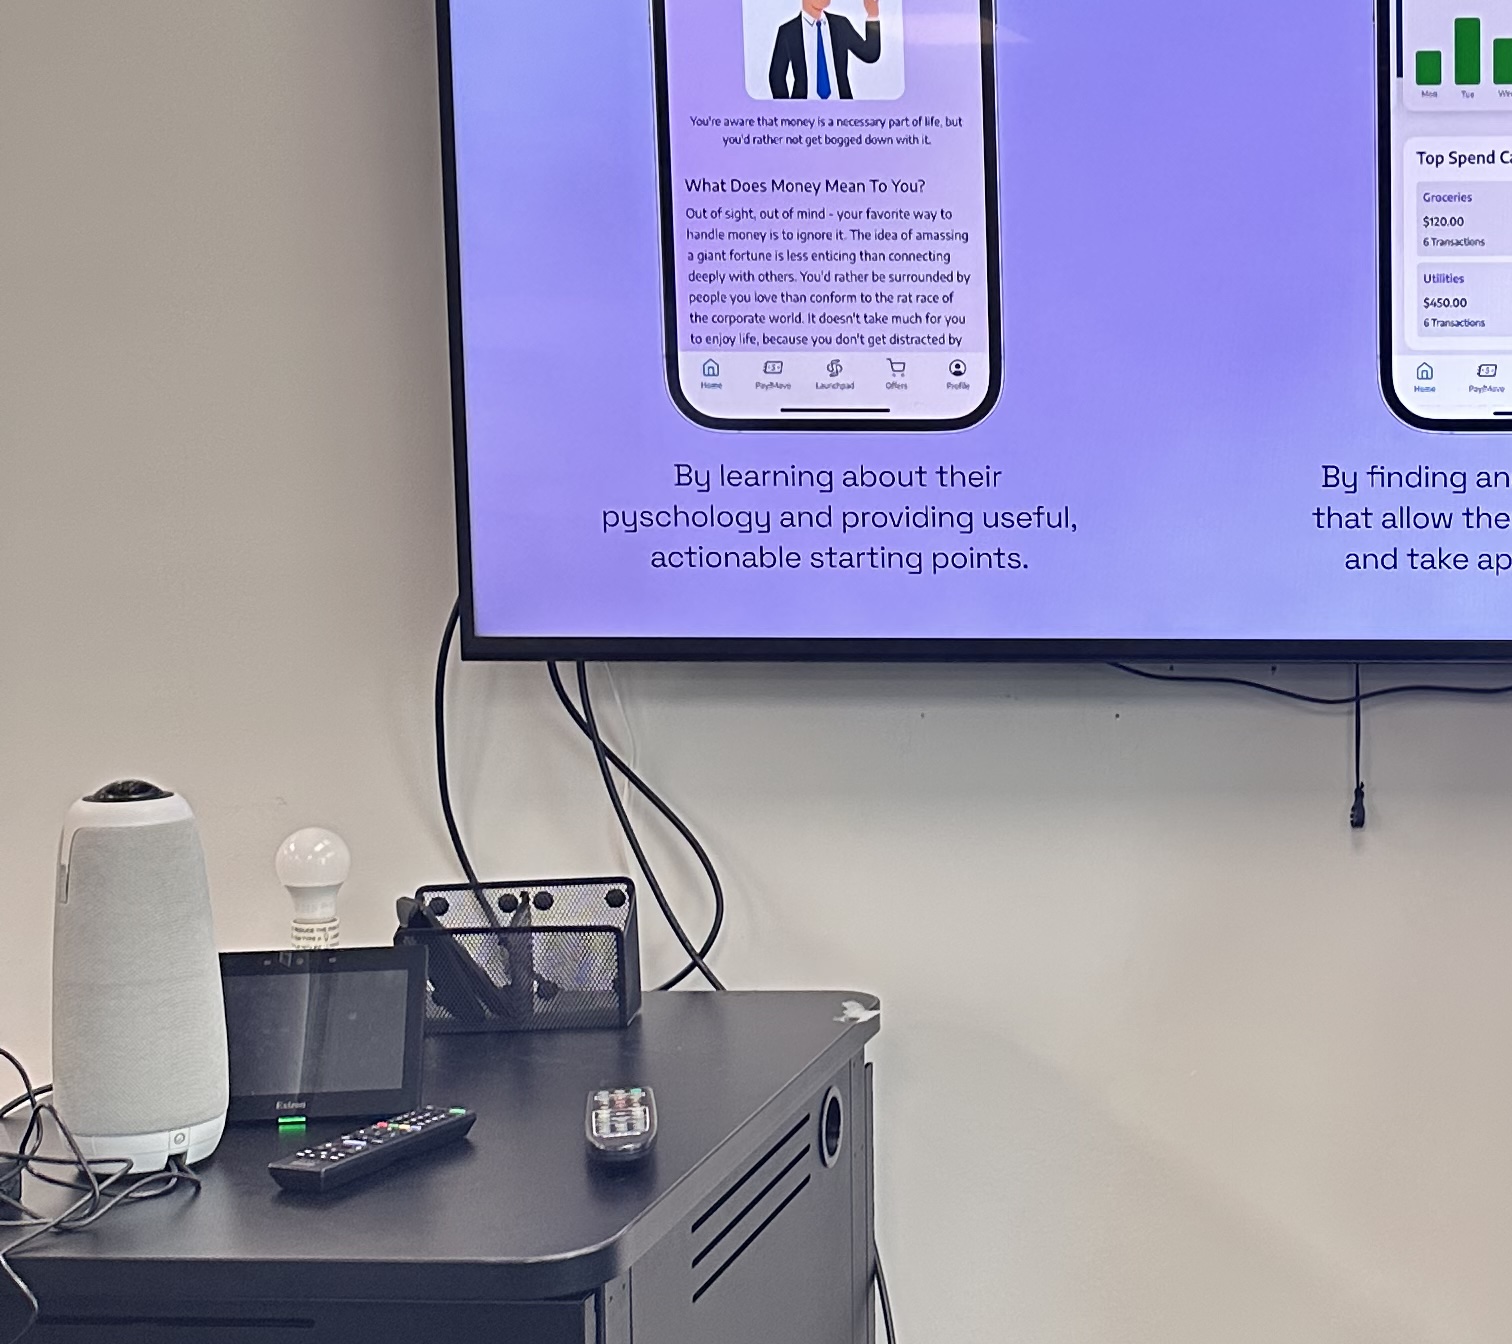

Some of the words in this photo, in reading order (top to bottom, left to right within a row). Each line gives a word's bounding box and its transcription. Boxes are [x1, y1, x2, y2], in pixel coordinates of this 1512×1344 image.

[1415, 151, 1444, 168] Top
[1448, 149, 1495, 168] Spend
[684, 177, 726, 192] What
[730, 178, 767, 192] Does
[771, 178, 821, 196] Money
[825, 178, 865, 193] Mean
[868, 178, 887, 192] To
[890, 178, 925, 193] You?
[1422, 191, 1472, 202] Groceries
[1422, 215, 1464, 228] $120.00
[1422, 236, 1429, 247] 6
[1430, 236, 1485, 246] Transactions
[1423, 273, 1464, 284] Utilities
[1423, 296, 1467, 309] $450.00
[690, 333, 702, 344] to
[705, 333, 736, 347] enjoy
[762, 332, 808, 345] because
[810, 335, 832, 347] you
[835, 332, 865, 345] don't
[867, 333, 886, 347] get
[889, 332, 945, 345] distracted
[948, 332, 962, 347] by
[673, 463, 710, 493] By
[720, 463, 833, 493] learning
[842, 463, 927, 488] about
[934, 463, 1002, 488] their
[1320, 464, 1357, 494] By
[1365, 464, 1467, 494] finding
[602, 503, 771, 534] pyschology
[779, 504, 832, 528] and
[841, 504, 973, 534] providing
[982, 504, 1077, 532] useful,
[1311, 505, 1374, 529] that
[1380, 505, 1453, 530] allow
[650, 544, 801, 569] actionable
[810, 545, 922, 575] starting
[932, 546, 1028, 575] points.
[1344, 546, 1398, 570] and
[1405, 546, 1469, 570] take
